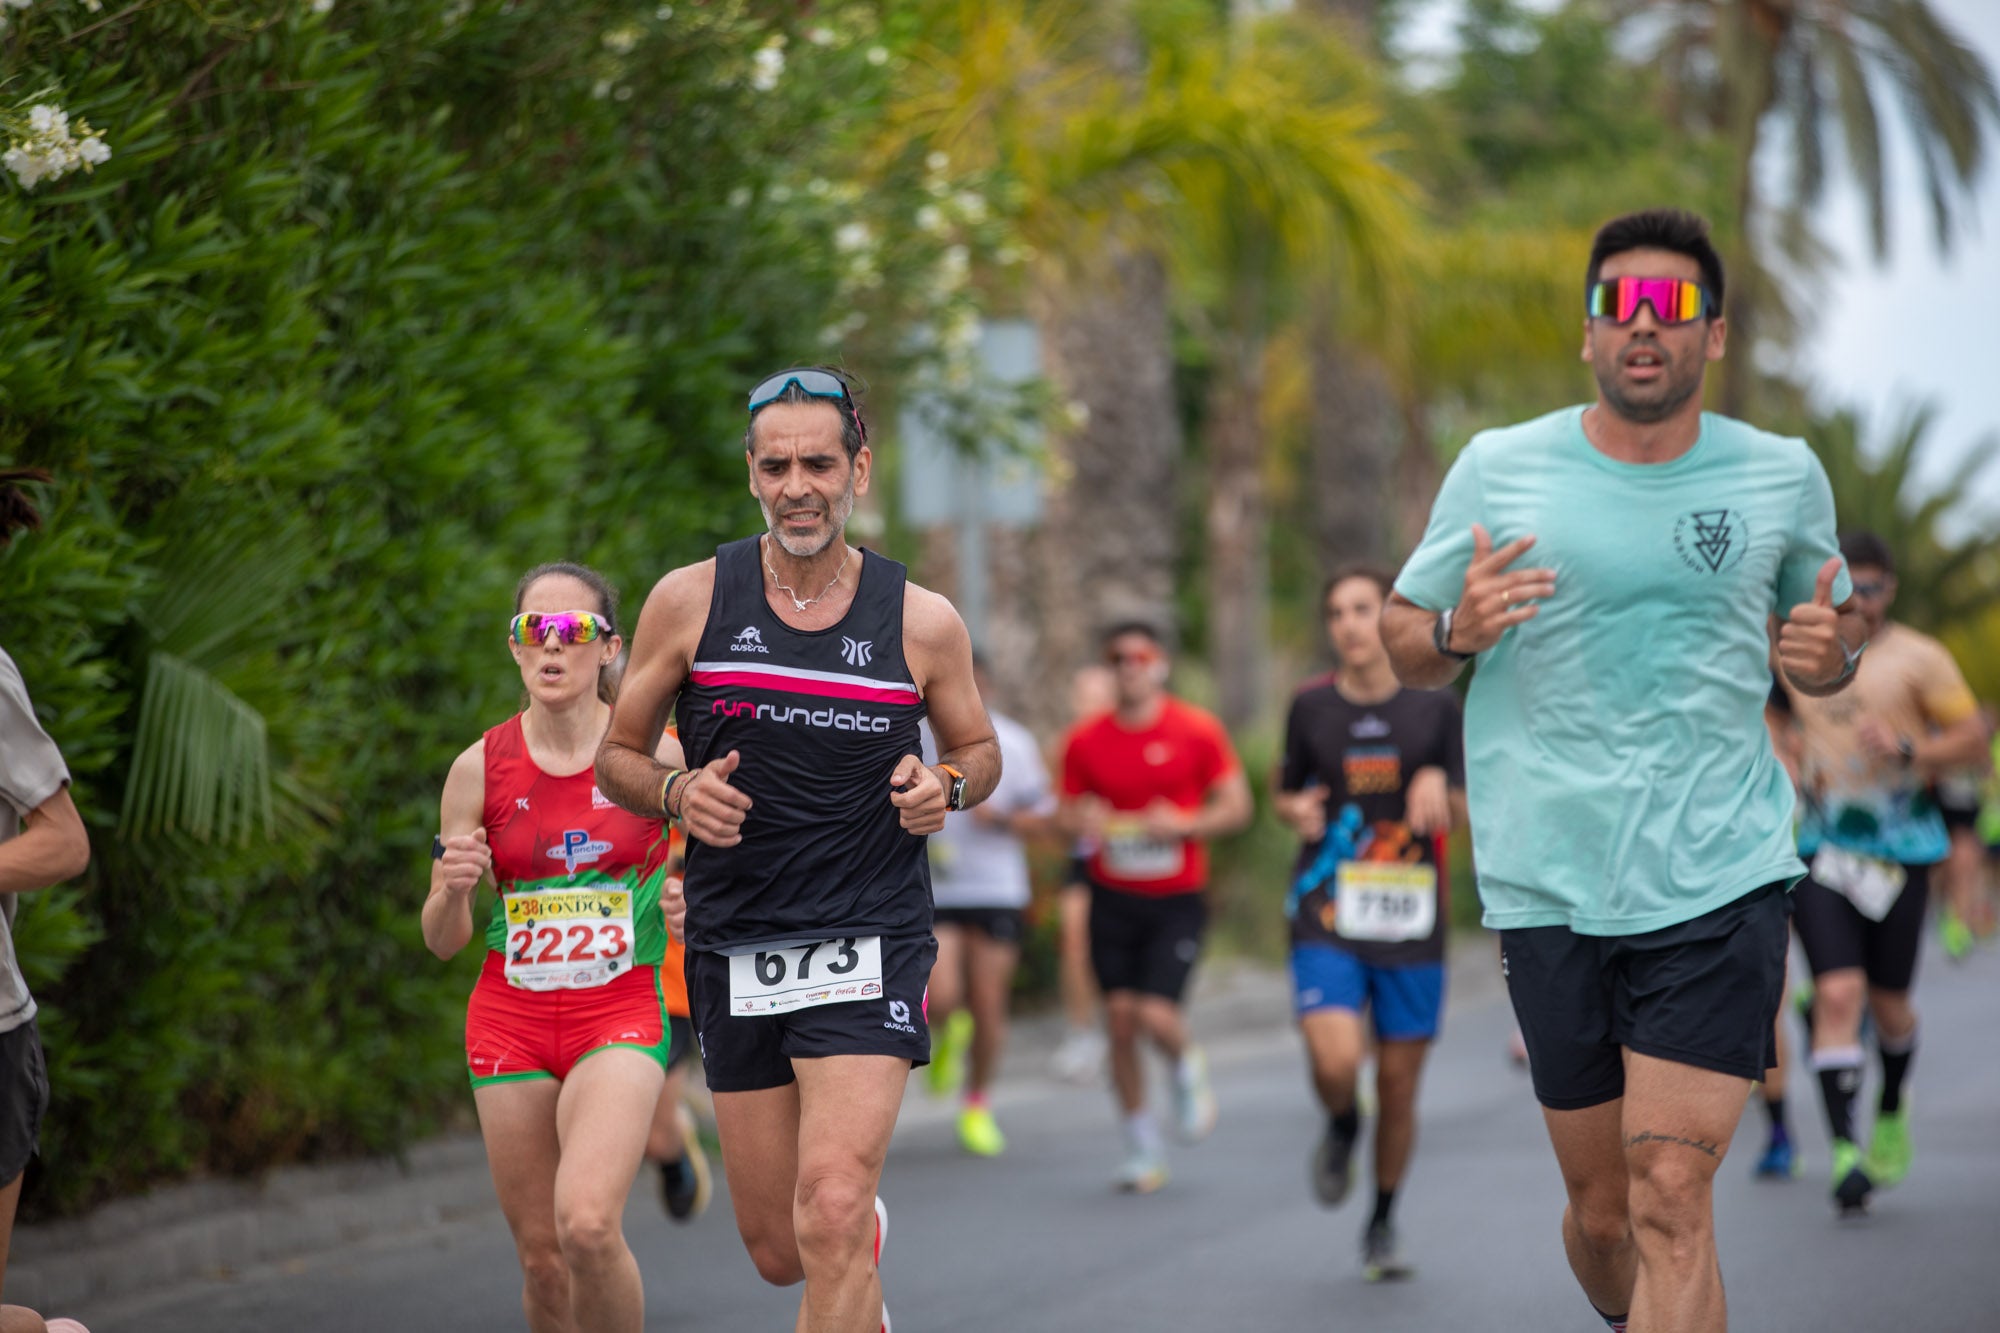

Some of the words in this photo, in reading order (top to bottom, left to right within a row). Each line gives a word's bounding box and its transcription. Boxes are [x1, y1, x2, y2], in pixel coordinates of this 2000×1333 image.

[730, 643, 770, 654] austral
[521, 899, 539, 916] 38
[540, 900, 602, 915] FONDO
[511, 925, 628, 966] 2223
[754, 937, 859, 986] 673
[884, 1021, 917, 1034] austral
